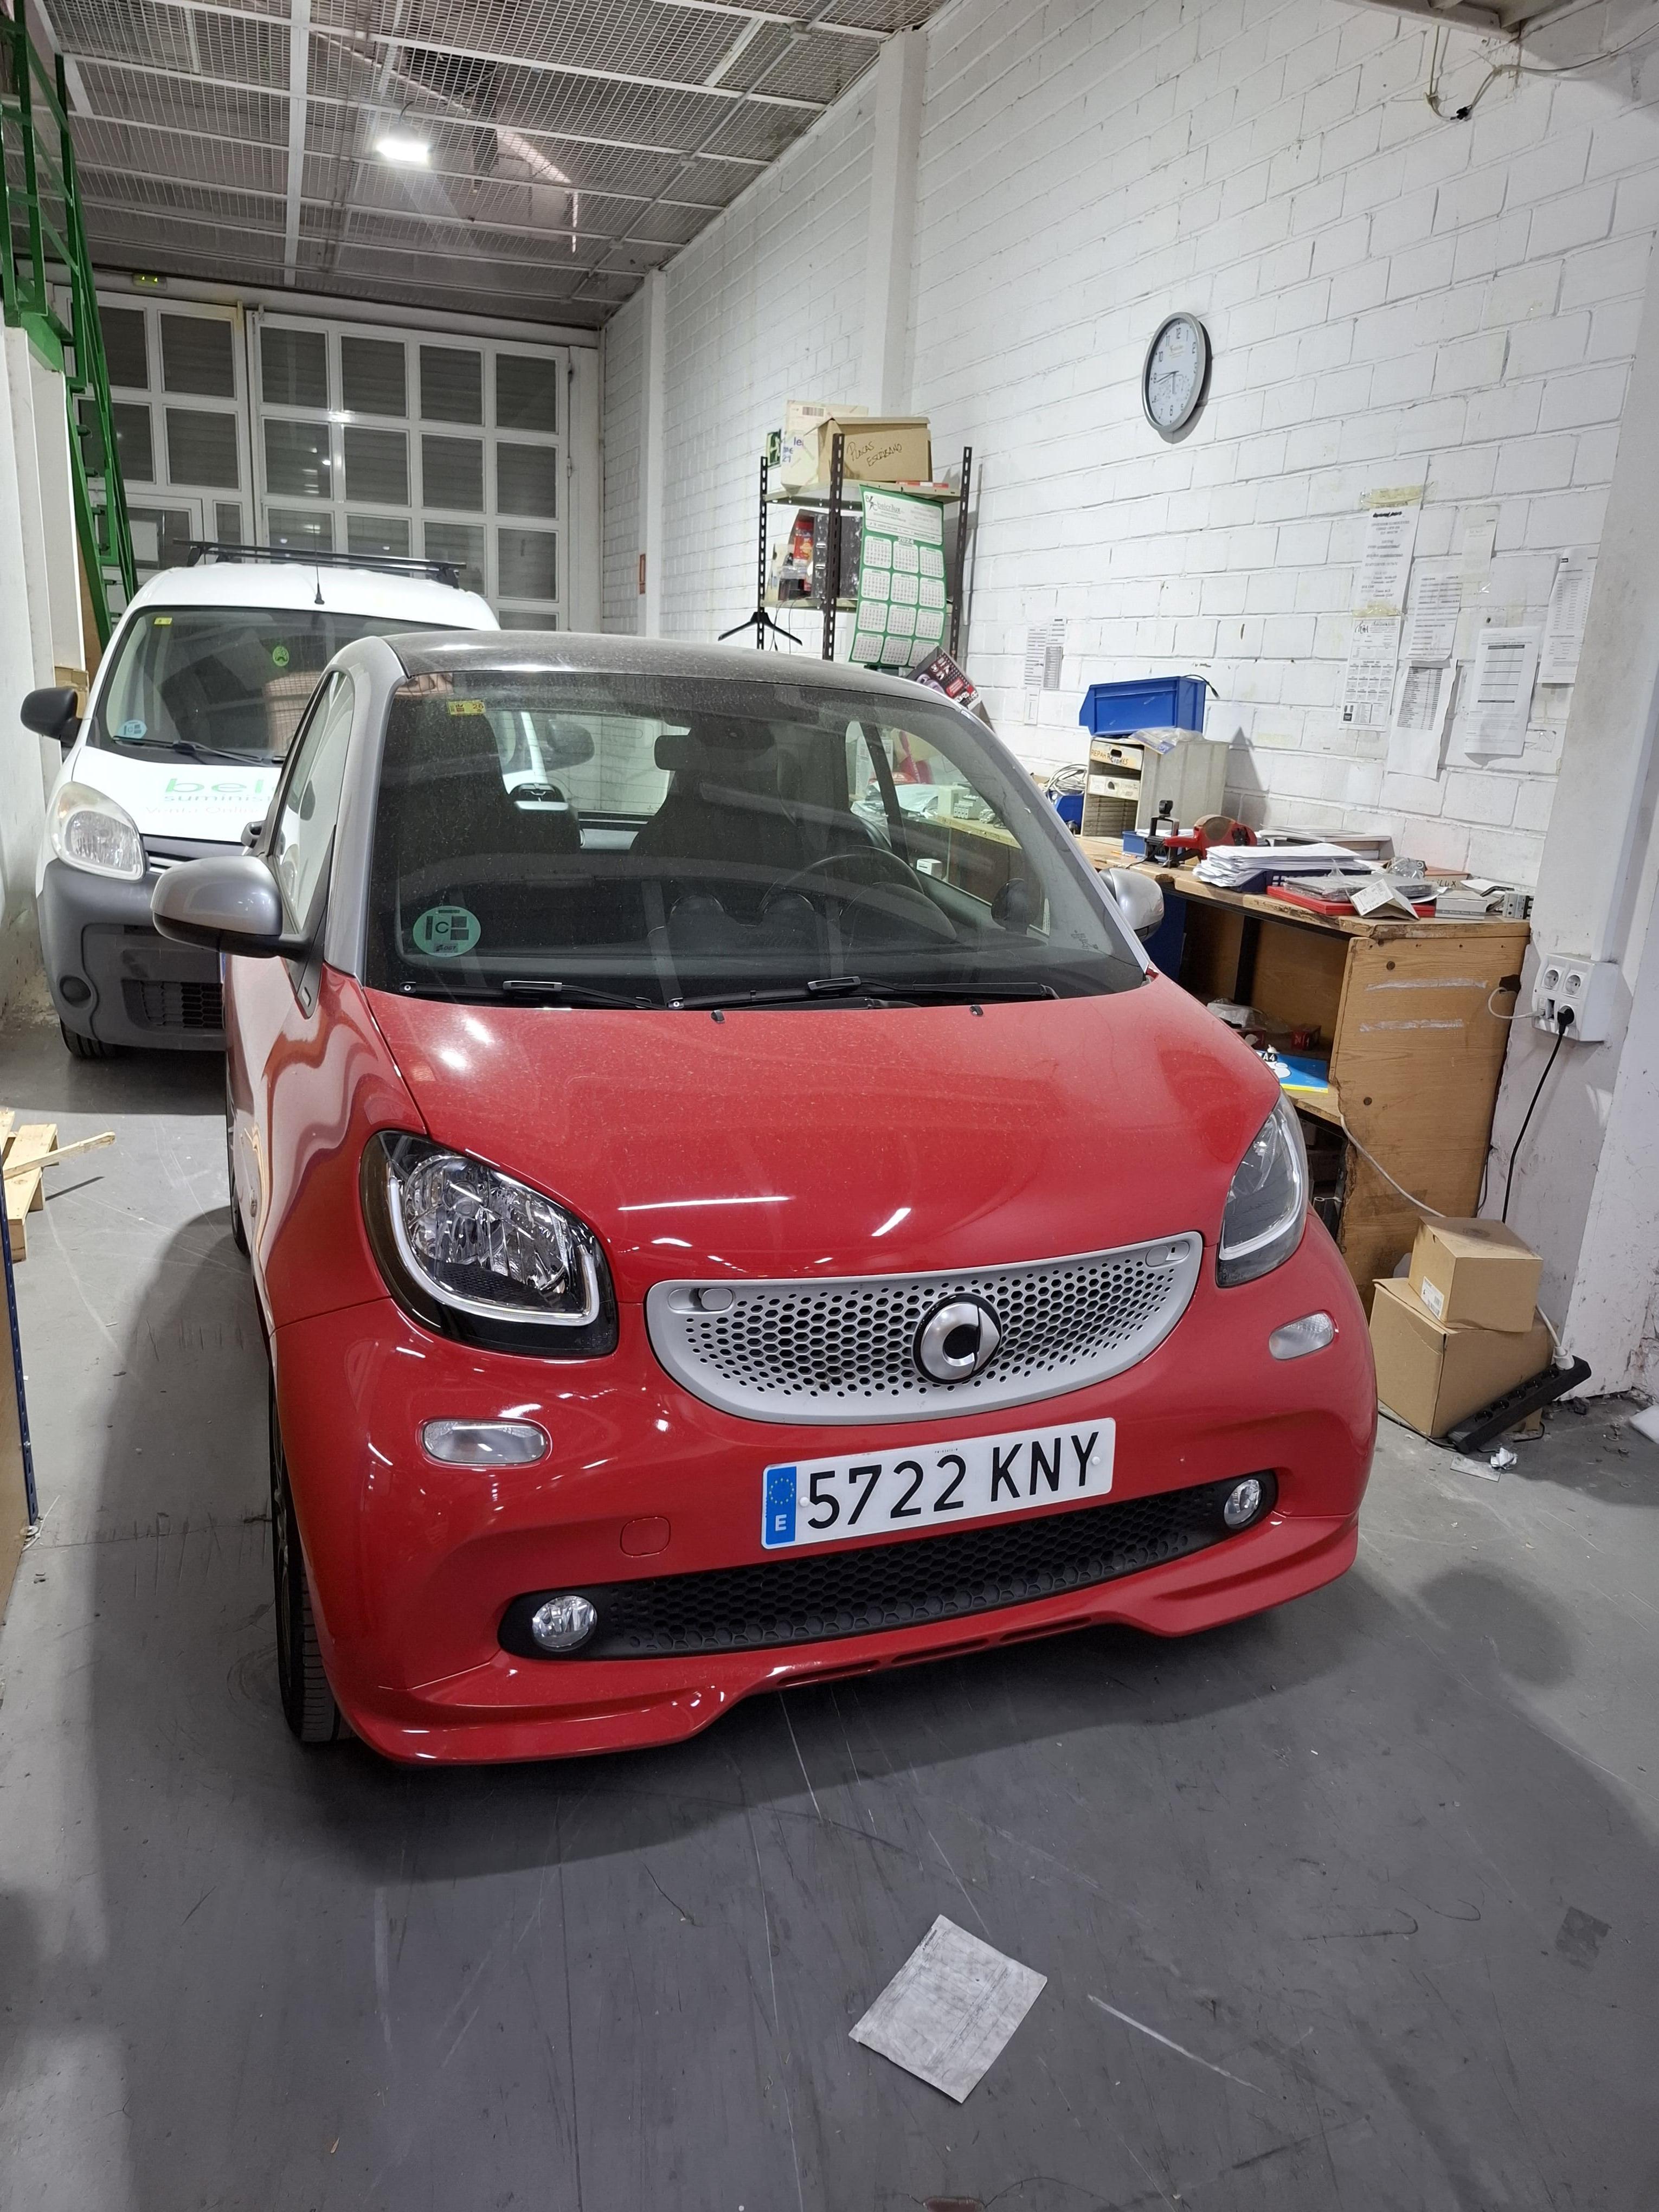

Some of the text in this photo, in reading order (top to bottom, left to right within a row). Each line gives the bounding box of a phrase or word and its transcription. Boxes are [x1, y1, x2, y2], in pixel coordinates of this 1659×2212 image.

[1176, 327, 1181, 339] 12
[1166, 335, 1170, 348] 11
[1159, 351, 1163, 362] 10
[846, 441, 874, 461] PLACAS
[867, 442, 903, 467] ESCRIBANO
[435, 921, 449, 934] C
[1263, 1053, 1275, 1061] A4
[807, 1431, 1099, 1529] 5722 KNY
[775, 1514, 787, 1532] E
